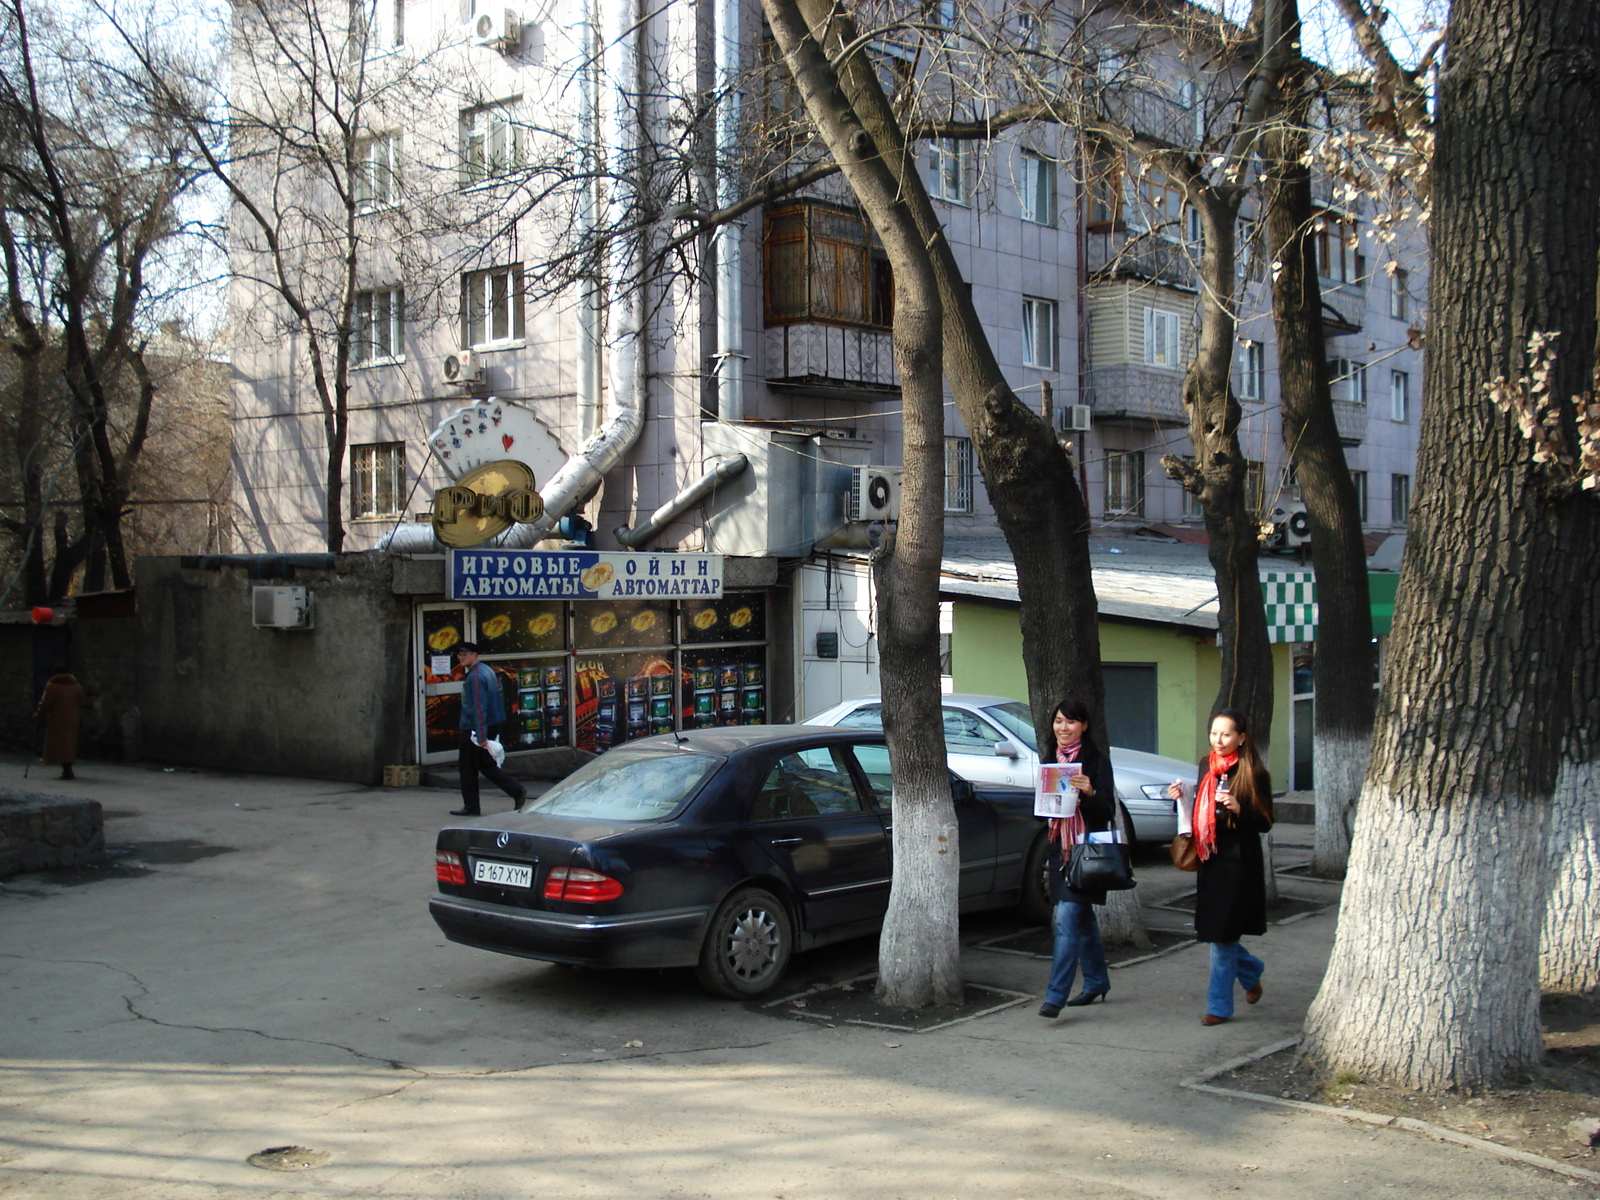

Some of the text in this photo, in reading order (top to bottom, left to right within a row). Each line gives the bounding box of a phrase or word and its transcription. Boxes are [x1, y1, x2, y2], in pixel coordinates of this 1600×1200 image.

[478, 407, 488, 418] K
[462, 556, 580, 575] ИГРОВЫЕ
[625, 556, 708, 576] ОЙЫН
[462, 577, 580, 596] АВТОМАТЫ
[612, 579, 720, 596] АВТОМАТТАР
[478, 863, 529, 885] B 167 XYM
